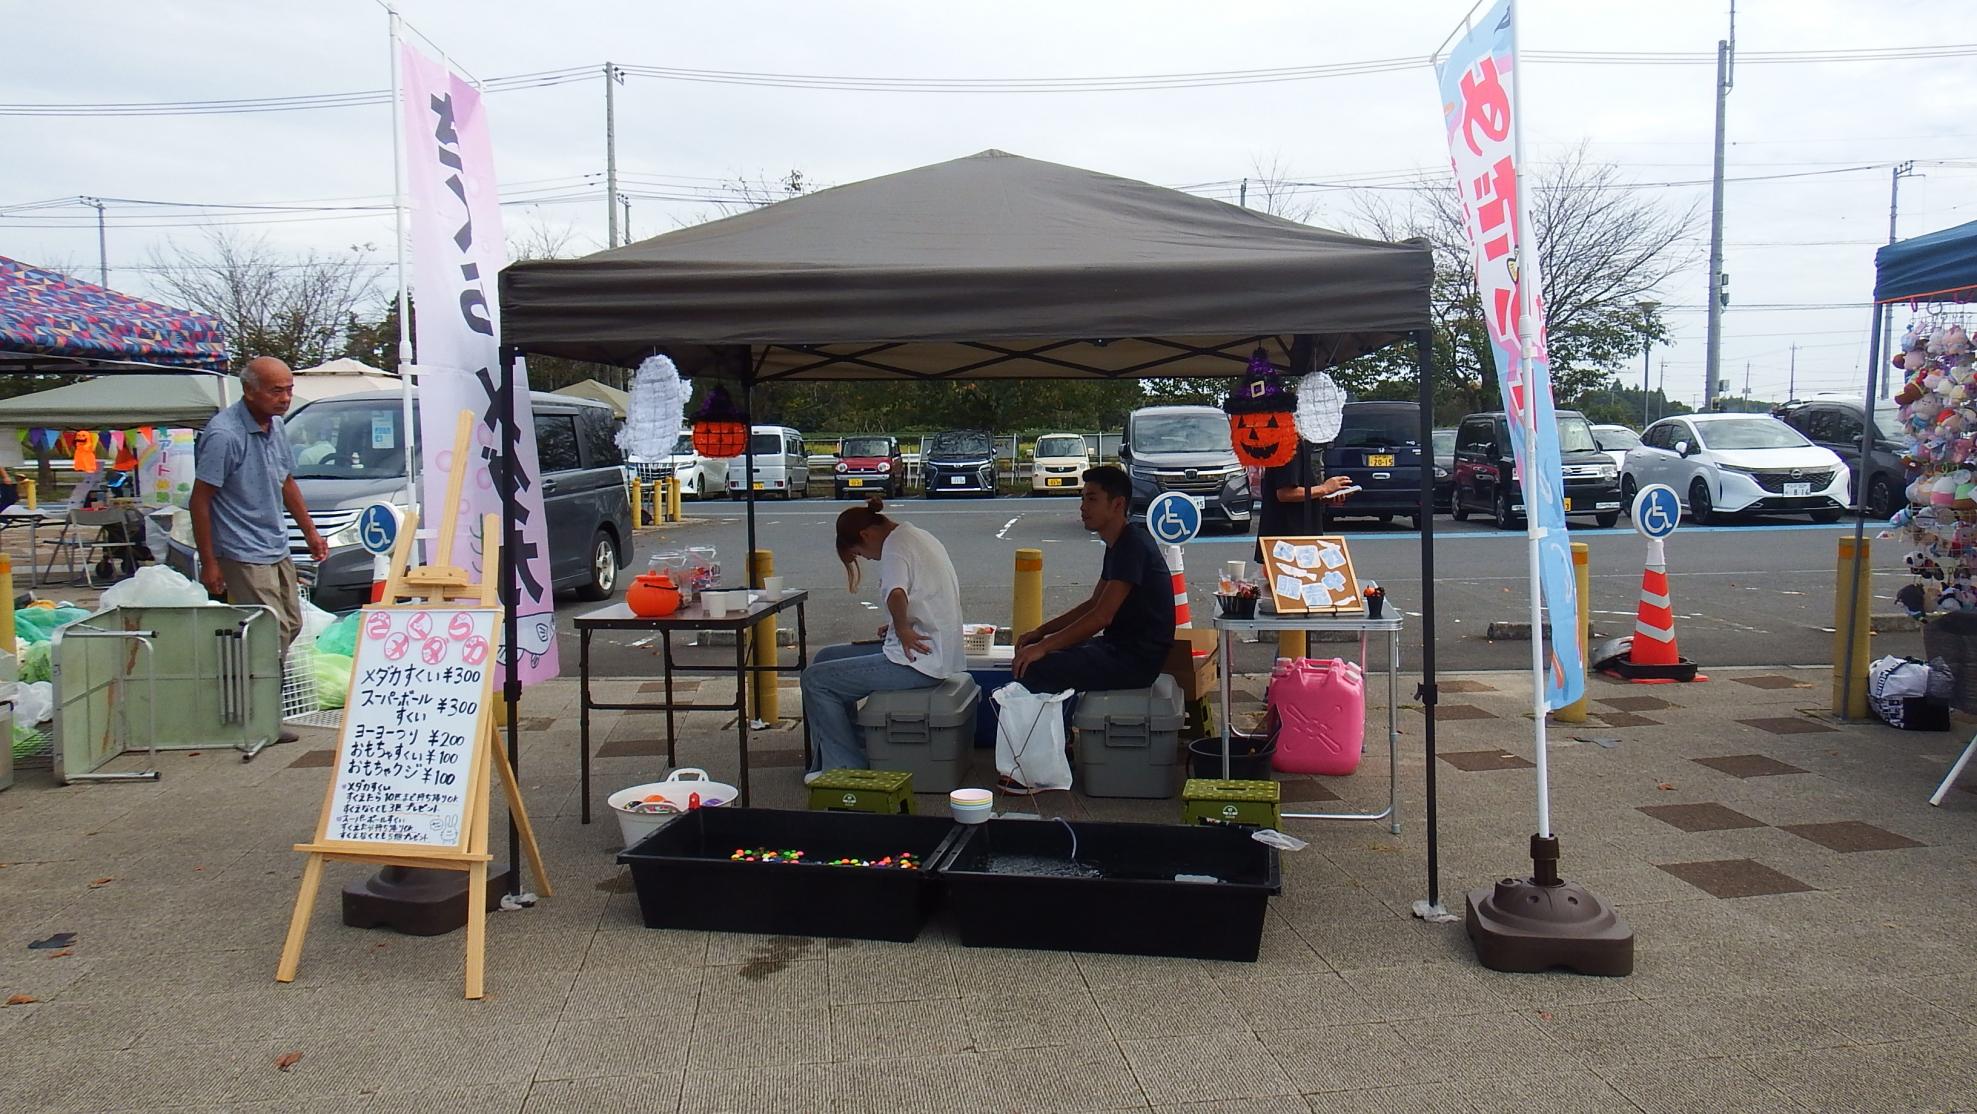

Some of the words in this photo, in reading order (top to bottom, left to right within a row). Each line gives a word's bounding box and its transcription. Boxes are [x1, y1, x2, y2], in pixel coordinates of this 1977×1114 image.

[366, 611, 475, 640] さくら
[361, 663, 440, 687] メダカすくい
[442, 666, 481, 684] ¥300
[361, 689, 433, 707] スーパーボール
[437, 697, 478, 717] ¥300
[396, 707, 427, 726] すくい
[355, 724, 419, 745] ヨーヨーつり
[428, 729, 465, 747] ¥200
[350, 740, 423, 761] おもちゃすくい
[426, 748, 459, 765] ¥100
[347, 758, 423, 779] おもちゃクジ
[422, 767, 456, 786] ¥100
